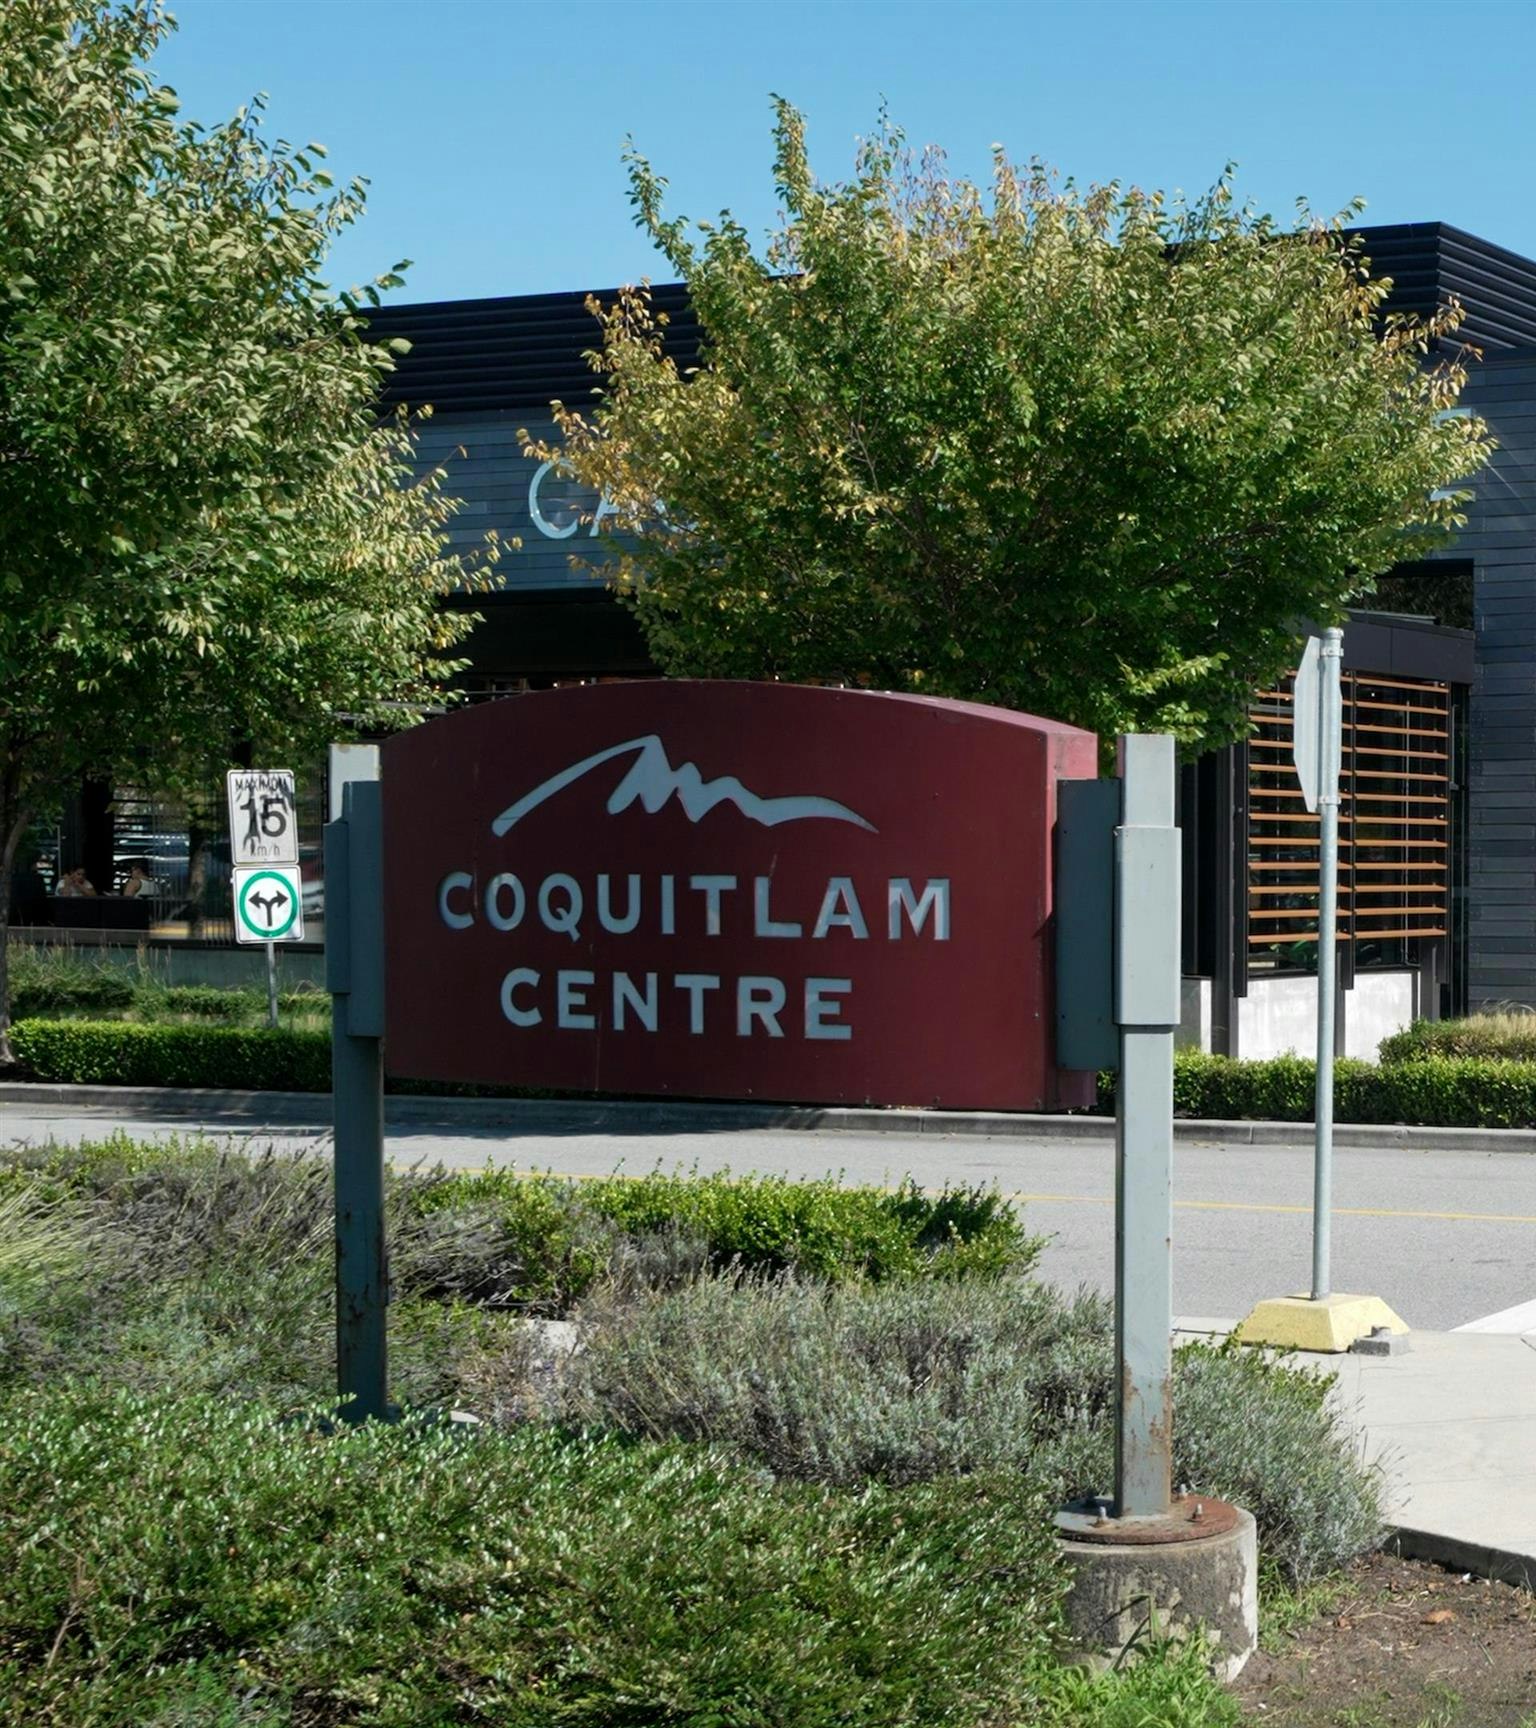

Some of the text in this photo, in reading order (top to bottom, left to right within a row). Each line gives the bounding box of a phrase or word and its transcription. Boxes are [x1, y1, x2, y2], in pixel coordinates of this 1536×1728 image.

[240, 797, 287, 837] 15
[250, 843, 281, 857] km/h
[438, 871, 951, 942] COQUITLAM
[500, 967, 854, 1040] CENTRE
